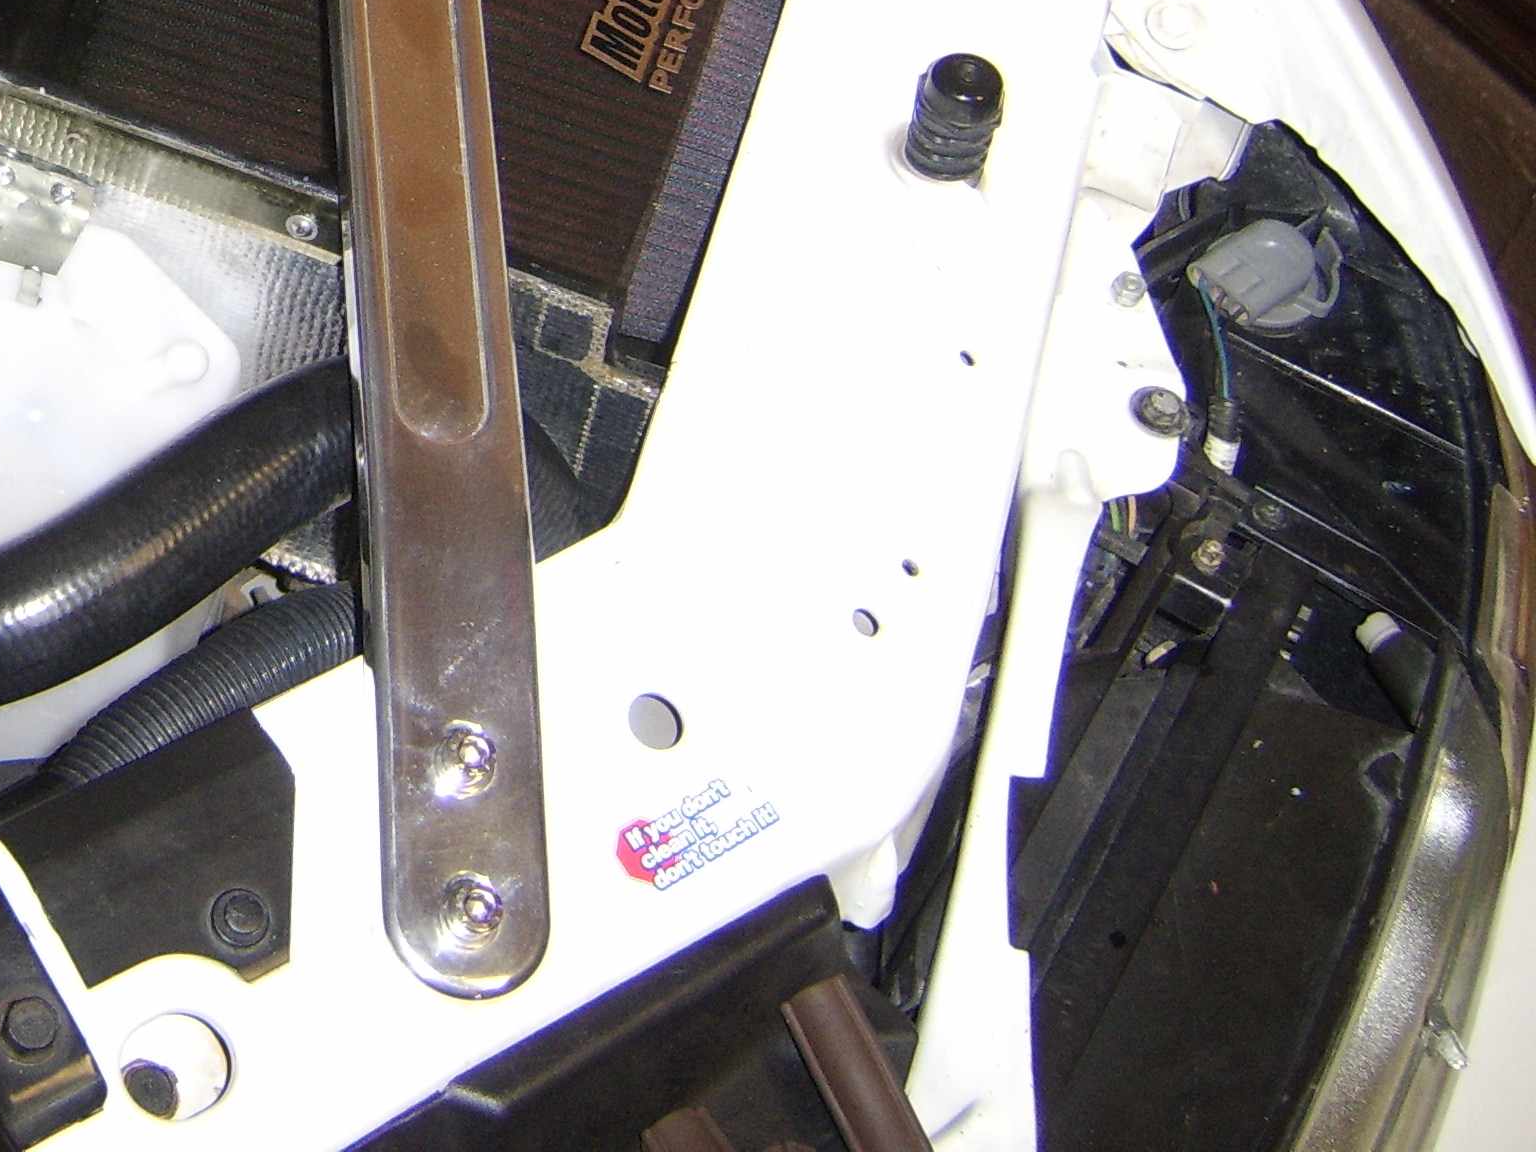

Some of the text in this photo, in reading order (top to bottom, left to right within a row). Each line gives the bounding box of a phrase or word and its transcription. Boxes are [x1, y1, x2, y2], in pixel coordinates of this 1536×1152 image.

[624, 826, 646, 852] If
[643, 808, 684, 845] you
[640, 829, 697, 871] clean
[698, 818, 759, 862] touch
